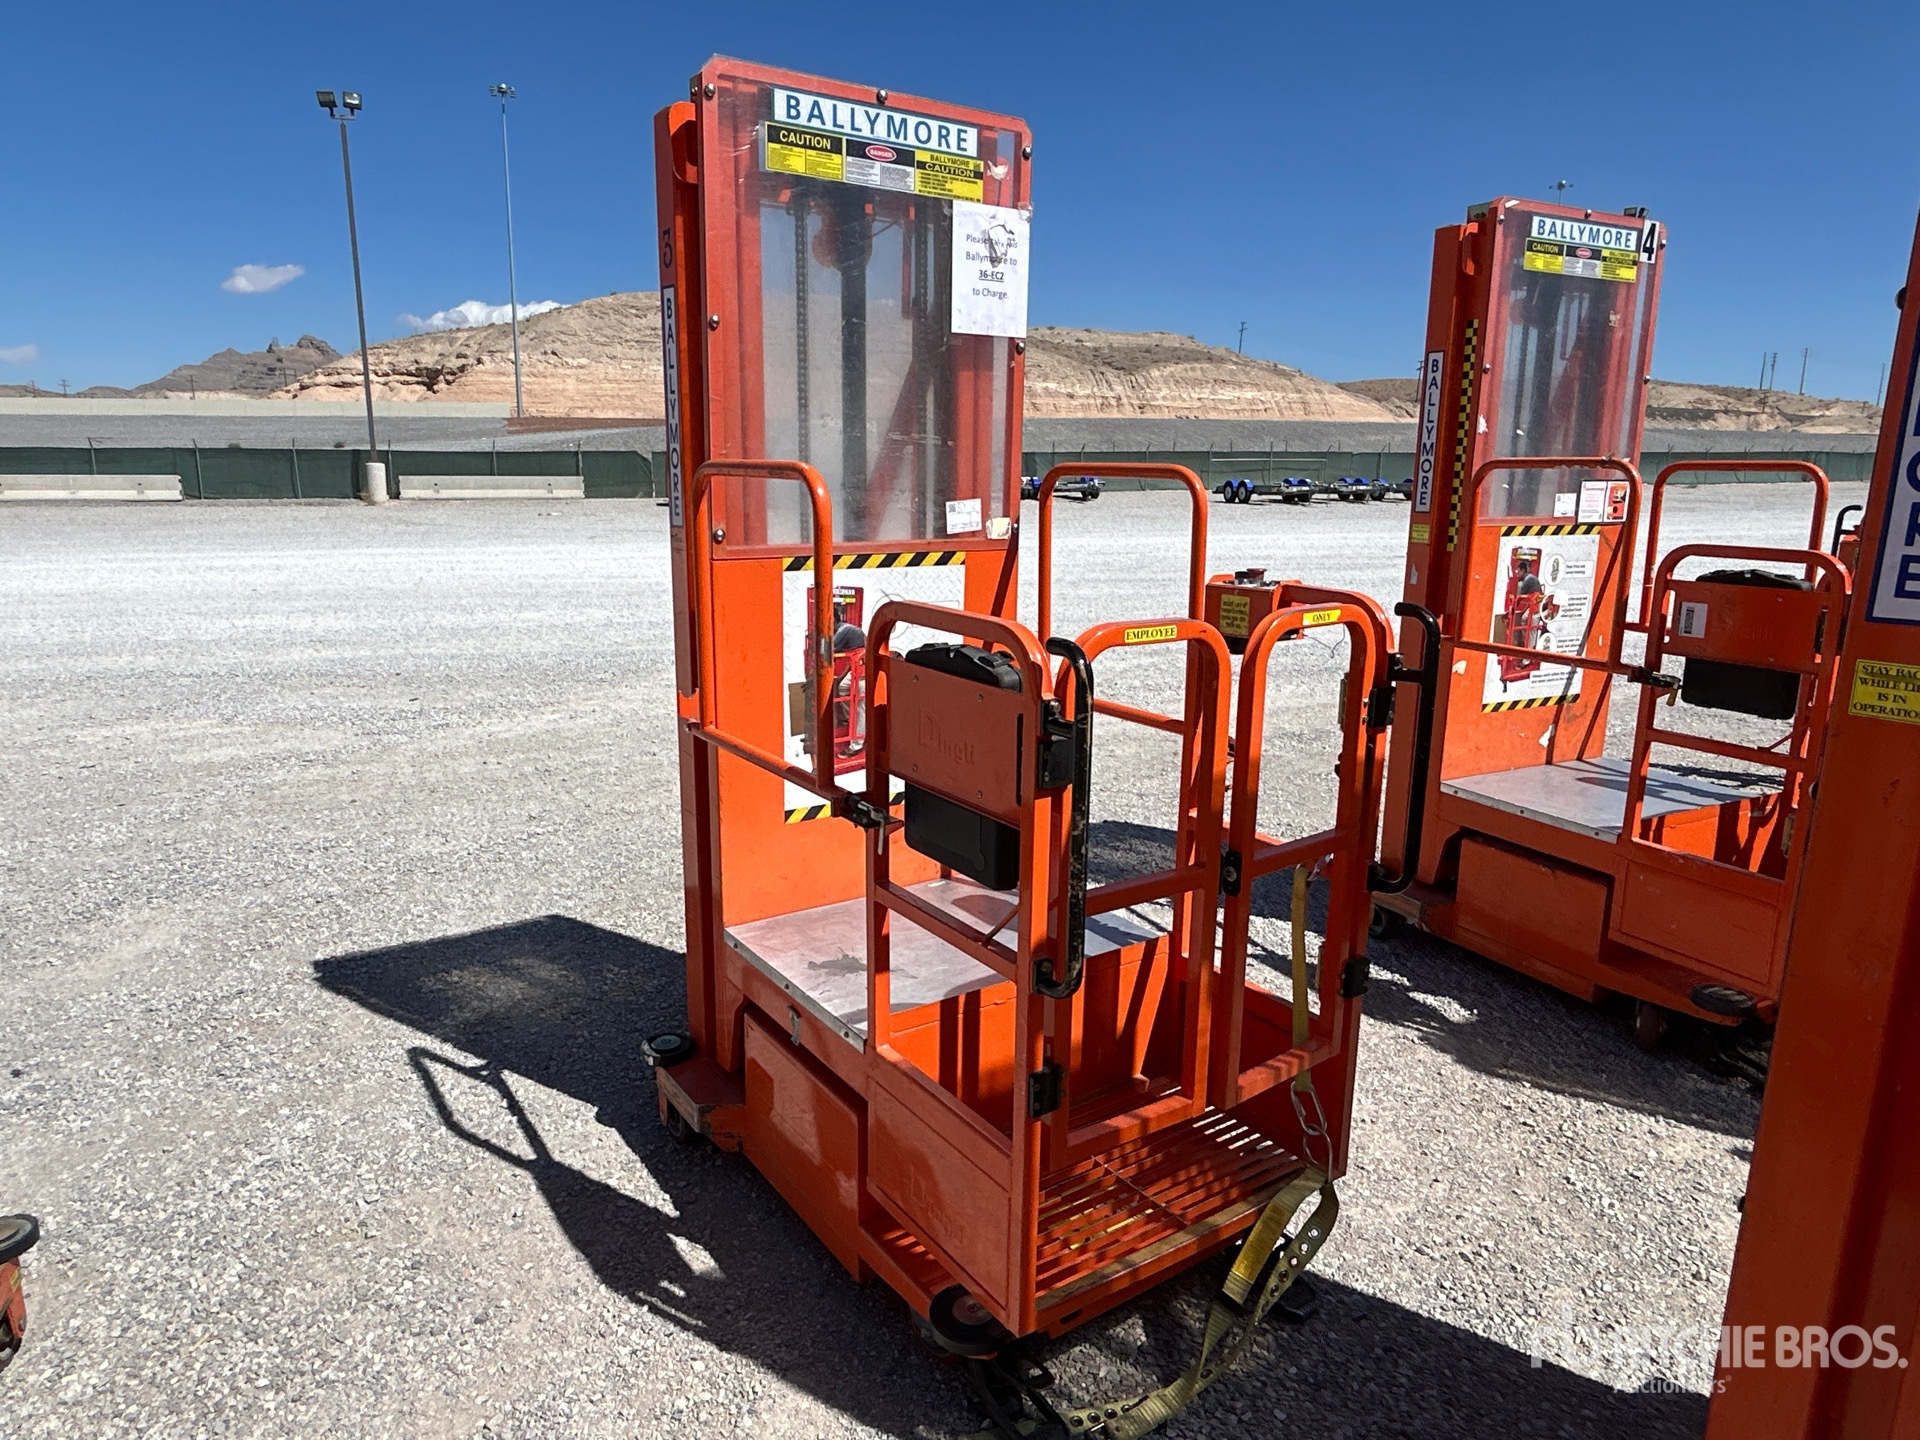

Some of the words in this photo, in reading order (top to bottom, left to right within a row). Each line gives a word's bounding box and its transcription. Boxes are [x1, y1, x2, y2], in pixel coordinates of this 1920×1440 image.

[785, 94, 968, 152] BALLYMORE
[780, 130, 831, 150] CAUTION
[930, 154, 970, 168] BALLYMORE
[925, 162, 974, 178] CAUTION
[966, 233, 988, 245] Please
[1537, 219, 1632, 248] BALLYMORE
[1532, 242, 1559, 253] CAUTION
[1643, 223, 1657, 262] 4
[965, 251, 1008, 264] Ballyme
[1009, 257, 1018, 266] to
[978, 269, 1004, 281] 36-EC2
[972, 287, 981, 296] to
[666, 297, 680, 517] BALLYMORE
[1419, 358, 1439, 506] BALLYMORE
[1126, 626, 1175, 641] EMPLOYEE
[1862, 664, 1892, 676] STAY
[1896, 668, 1920, 680] BAC
[1859, 676, 1900, 690] WHILE
[1904, 682, 1920, 693] LI
[1877, 692, 1889, 701] IS
[1892, 693, 1907, 704] IN
[1853, 701, 1920, 719] OPERATIO
